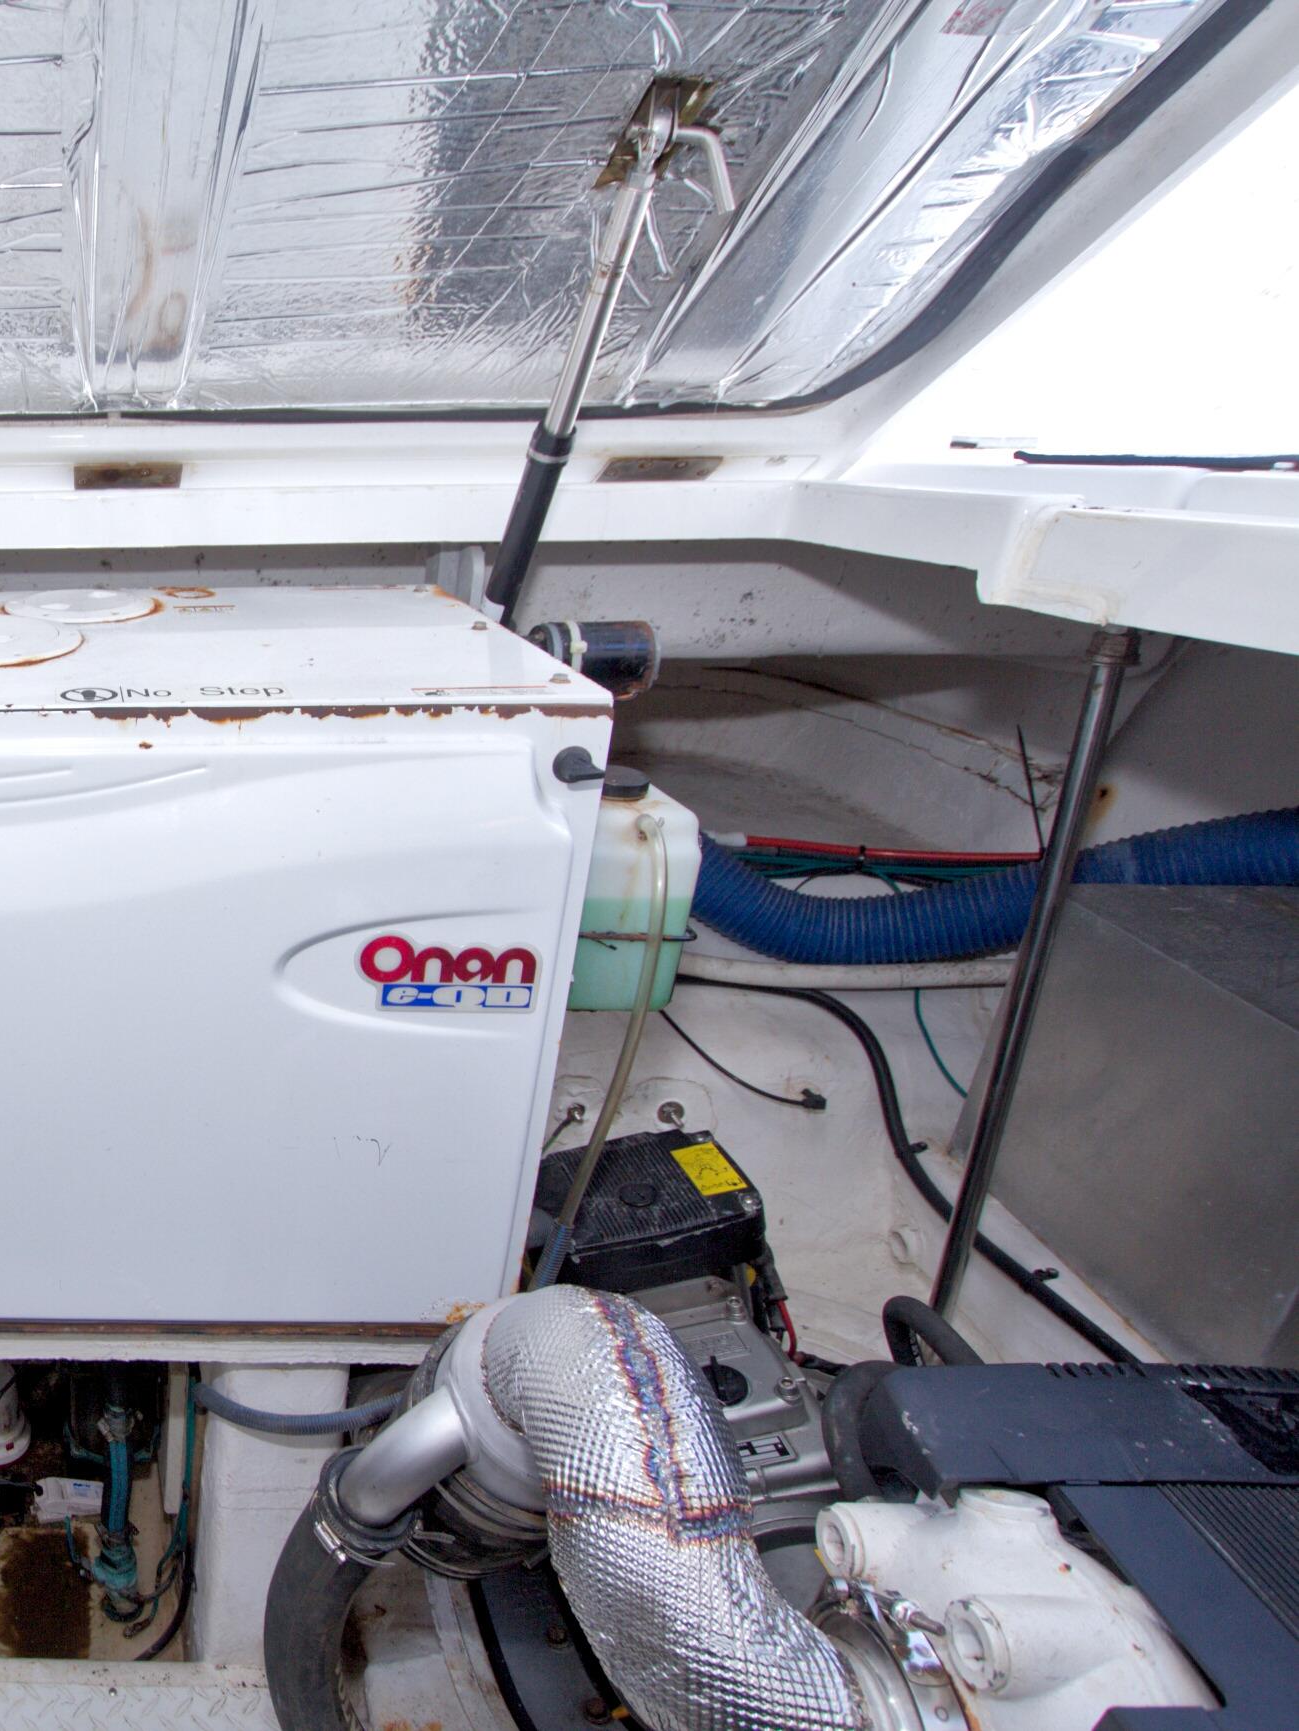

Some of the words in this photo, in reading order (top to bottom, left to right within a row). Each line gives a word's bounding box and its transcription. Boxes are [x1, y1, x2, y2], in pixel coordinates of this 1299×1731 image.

[127, 689, 171, 698] No
[199, 687, 284, 697] Step
[360, 936, 537, 984] Onan
